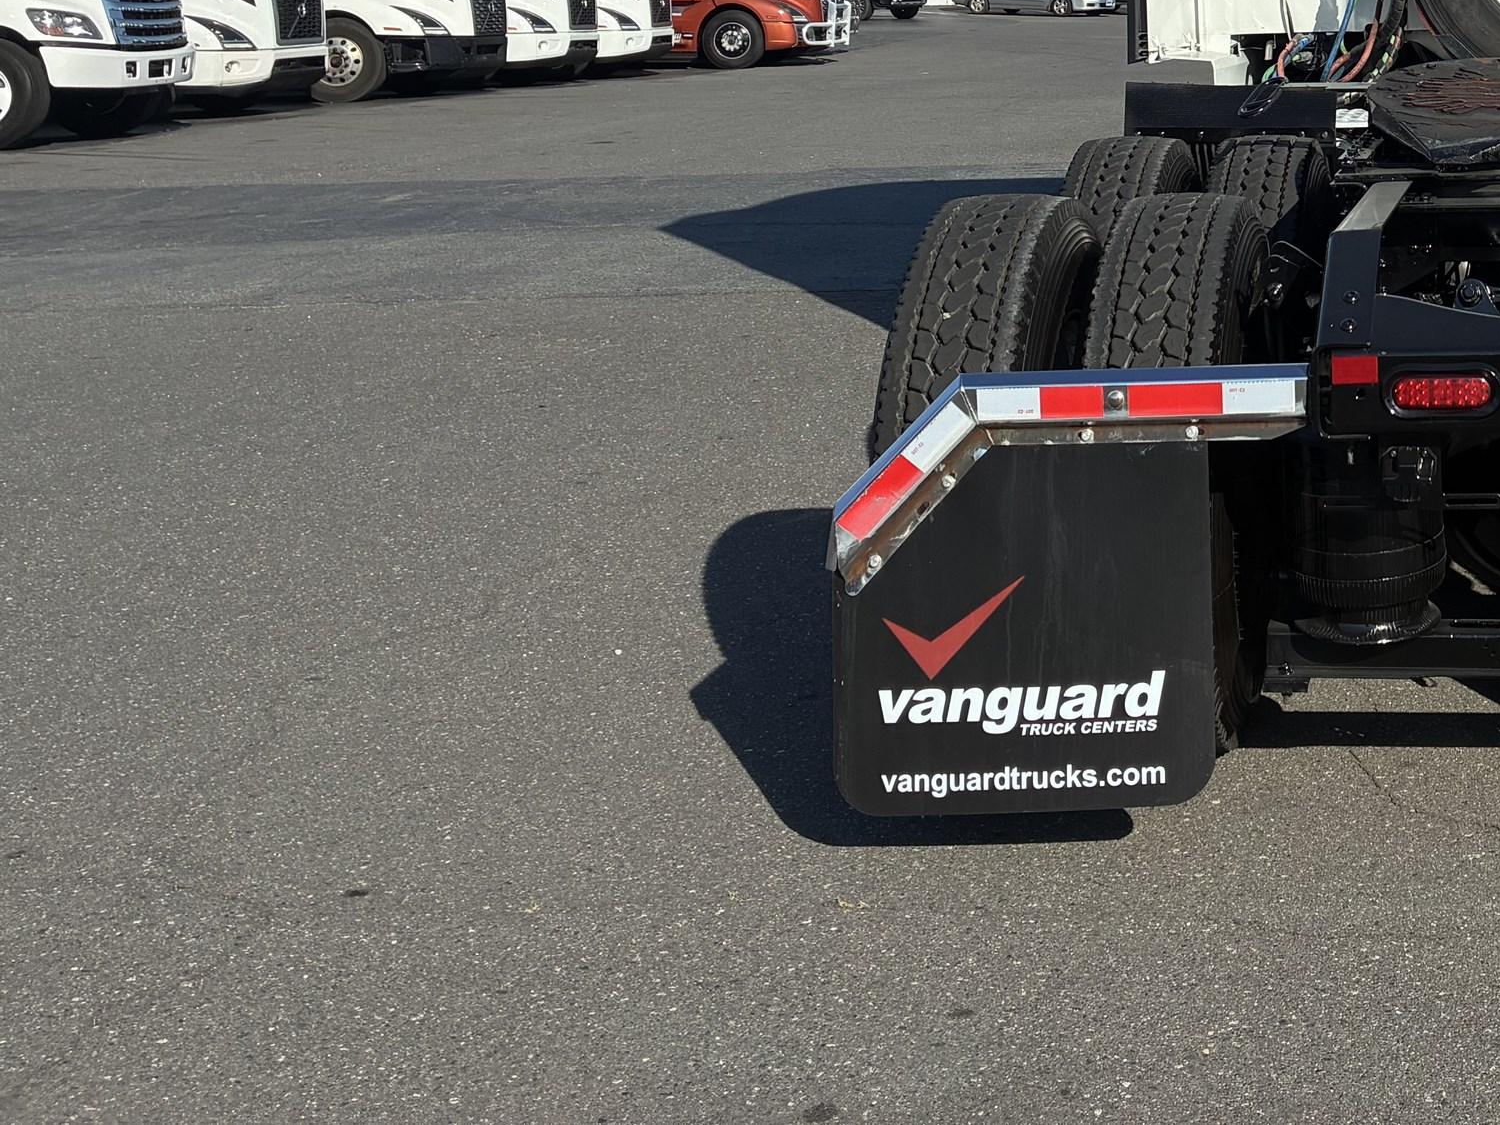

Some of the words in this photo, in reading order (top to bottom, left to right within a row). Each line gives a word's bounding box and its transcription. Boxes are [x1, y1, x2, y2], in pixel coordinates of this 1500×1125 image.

[879, 670, 1166, 735] vanguard
[1020, 722, 1076, 736] TRUCK
[1081, 719, 1158, 734] CENTERS
[881, 764, 1166, 798] vanguardtrucks.com
